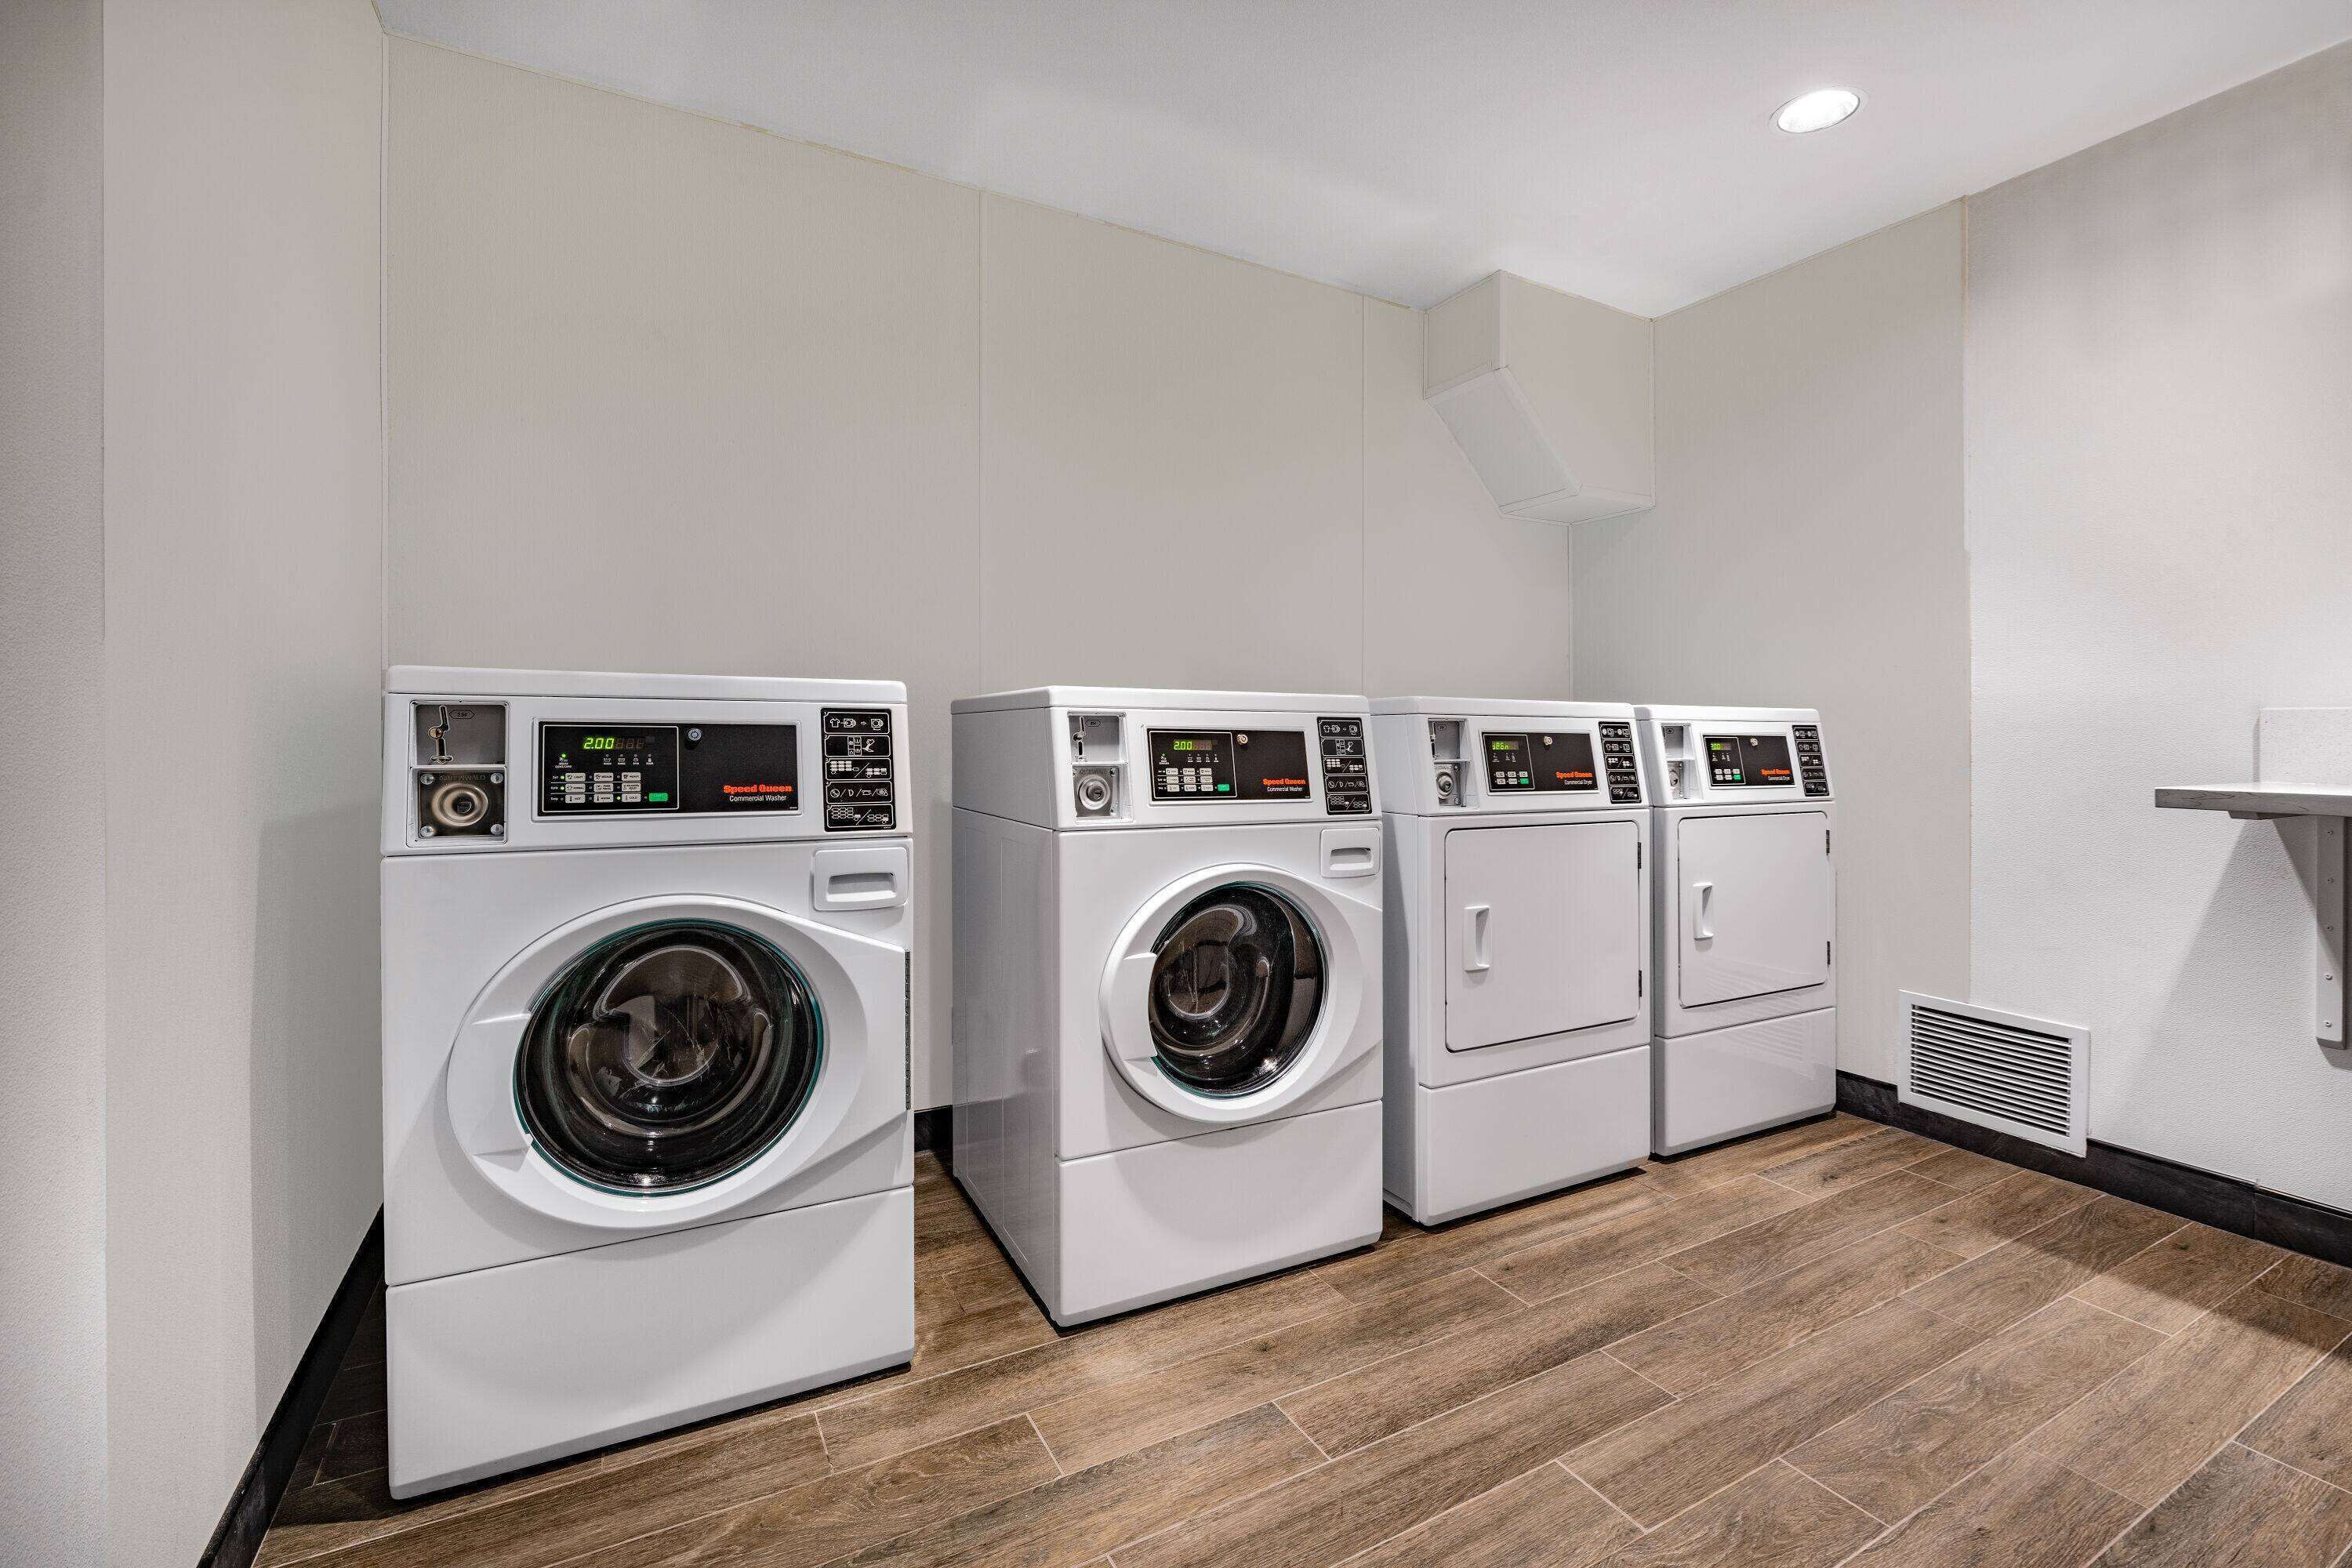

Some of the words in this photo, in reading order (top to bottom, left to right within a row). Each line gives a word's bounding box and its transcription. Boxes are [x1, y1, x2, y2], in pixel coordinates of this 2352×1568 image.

[584, 739, 615, 750] 2.00
[1174, 742, 1192, 750] 2.00
[724, 785, 757, 794] Speed
[759, 784, 793, 793] Queen
